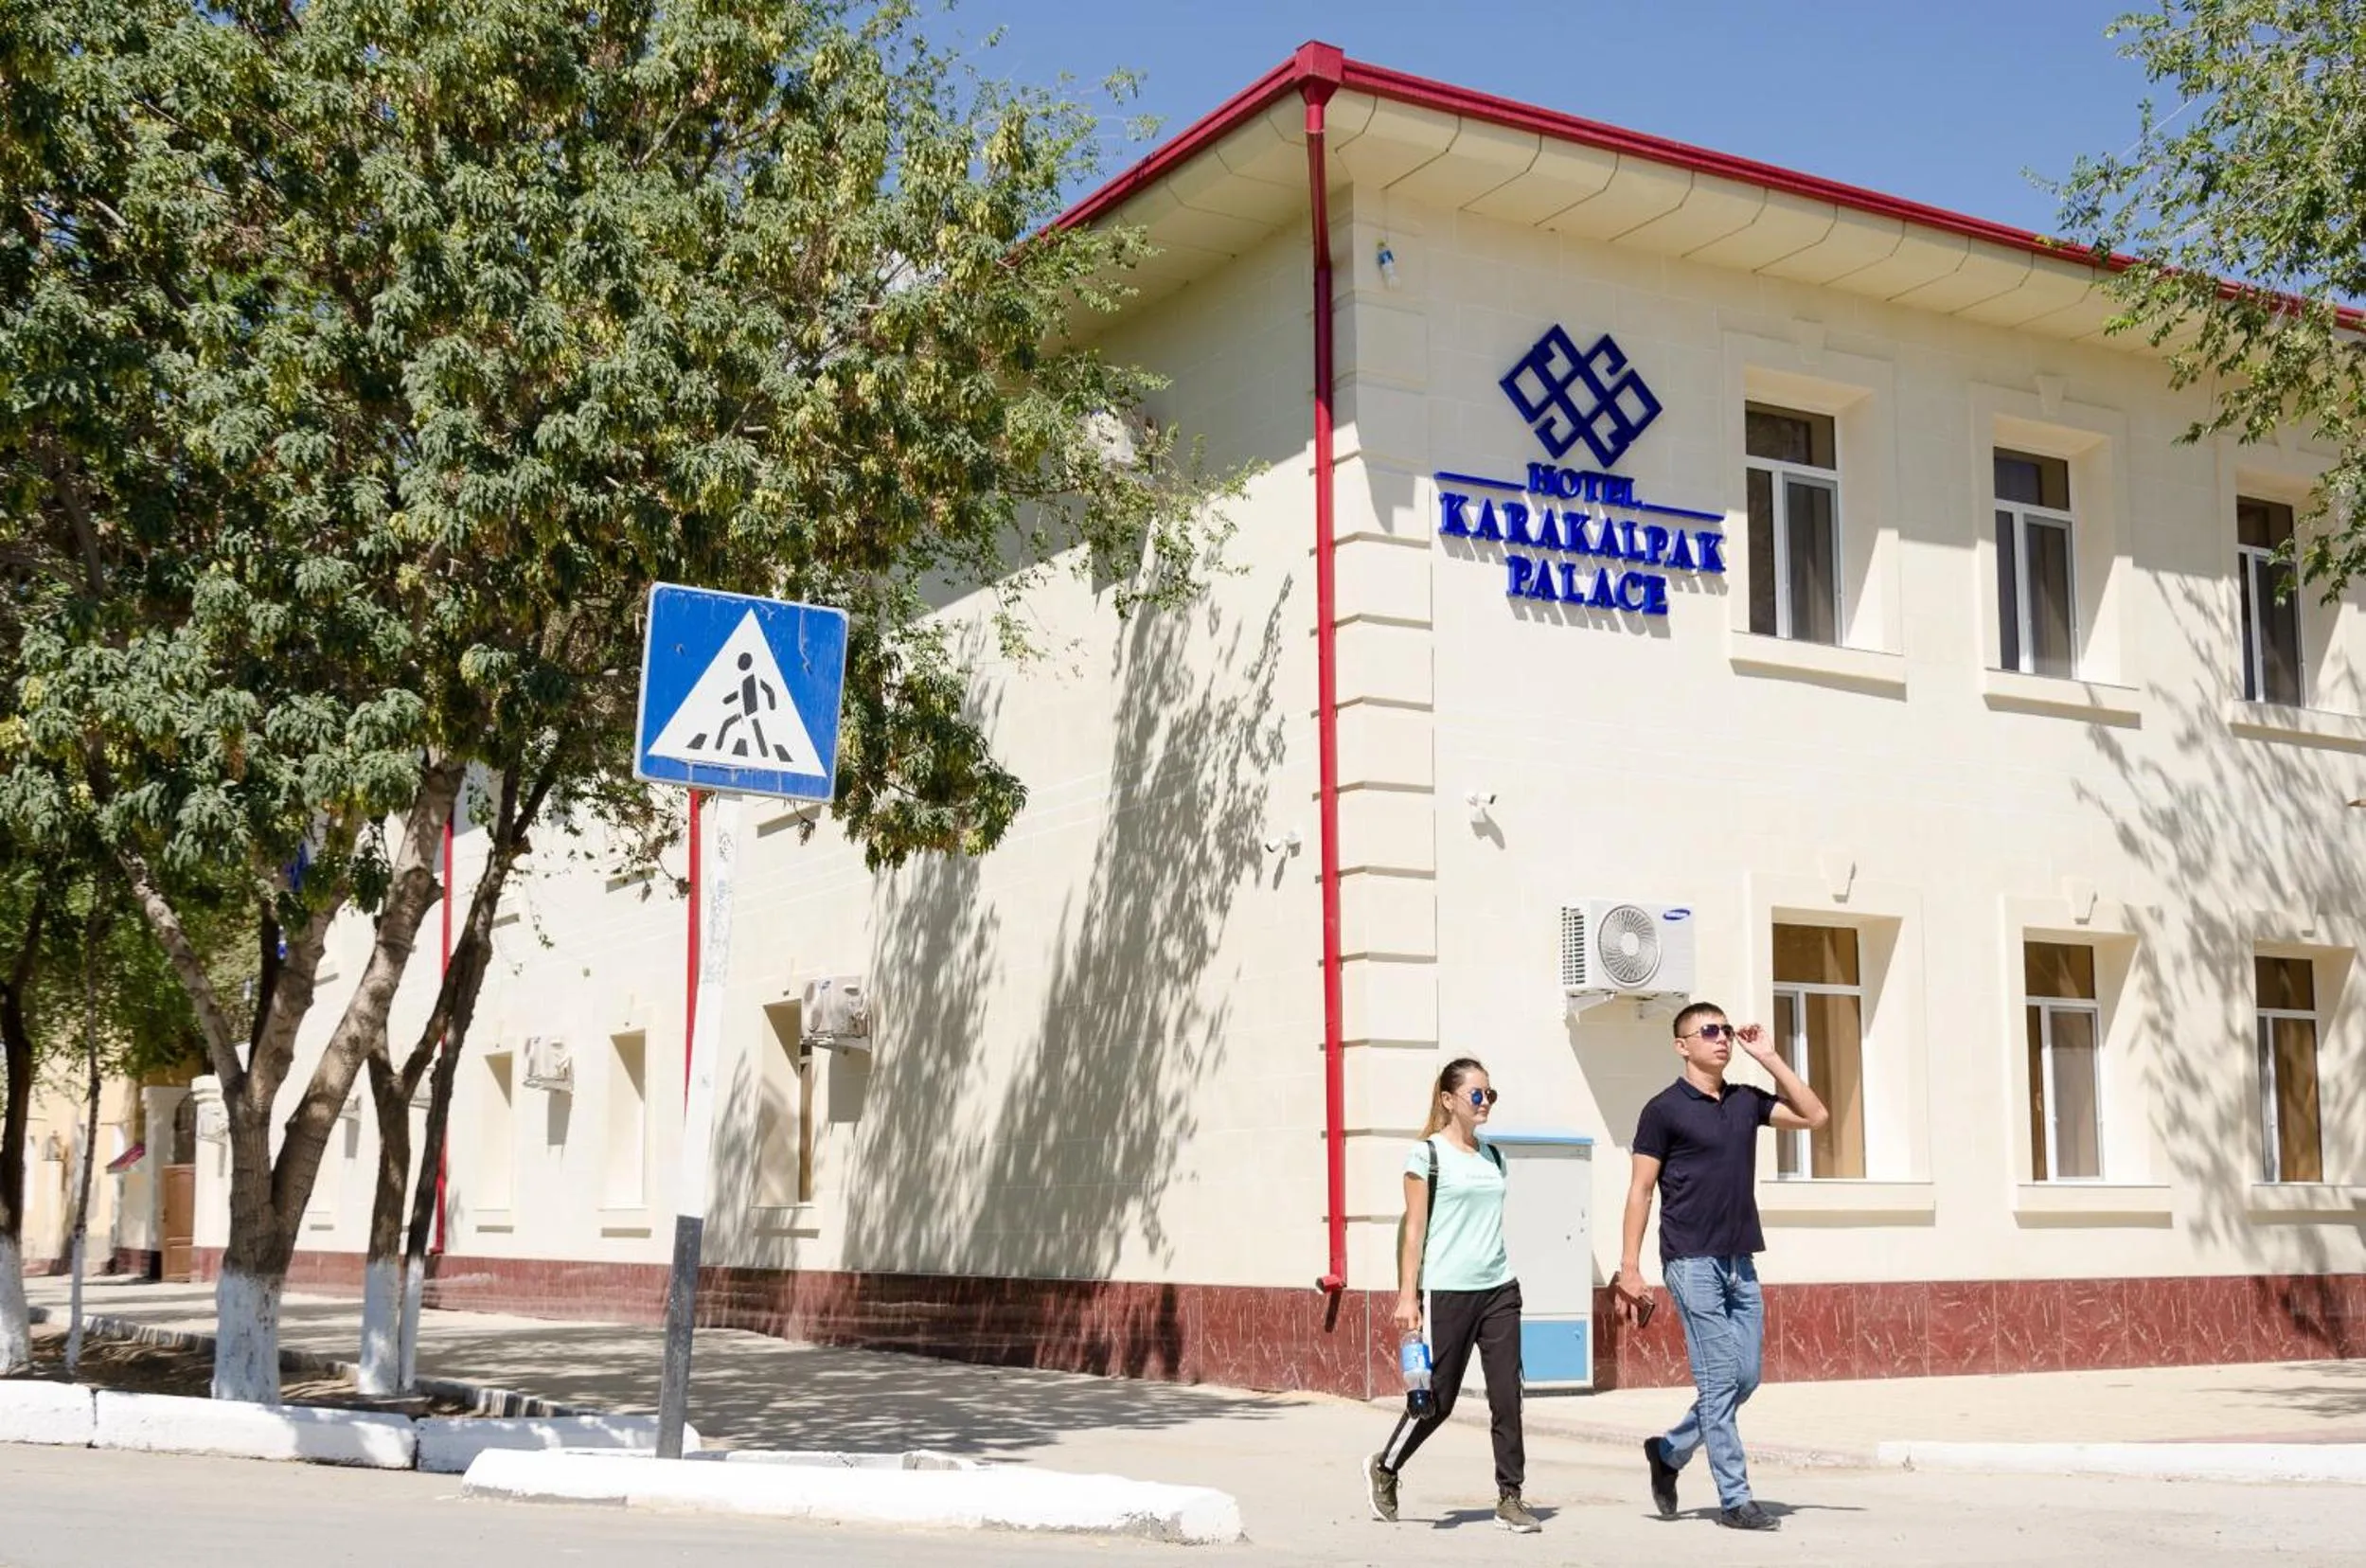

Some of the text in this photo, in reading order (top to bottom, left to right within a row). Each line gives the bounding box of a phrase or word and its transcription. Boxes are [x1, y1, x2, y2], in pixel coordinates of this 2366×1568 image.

[1526, 462, 1643, 509] HOTEL
[1438, 491, 1726, 572] KARAKALPAK
[1505, 555, 1668, 615] PALACE
